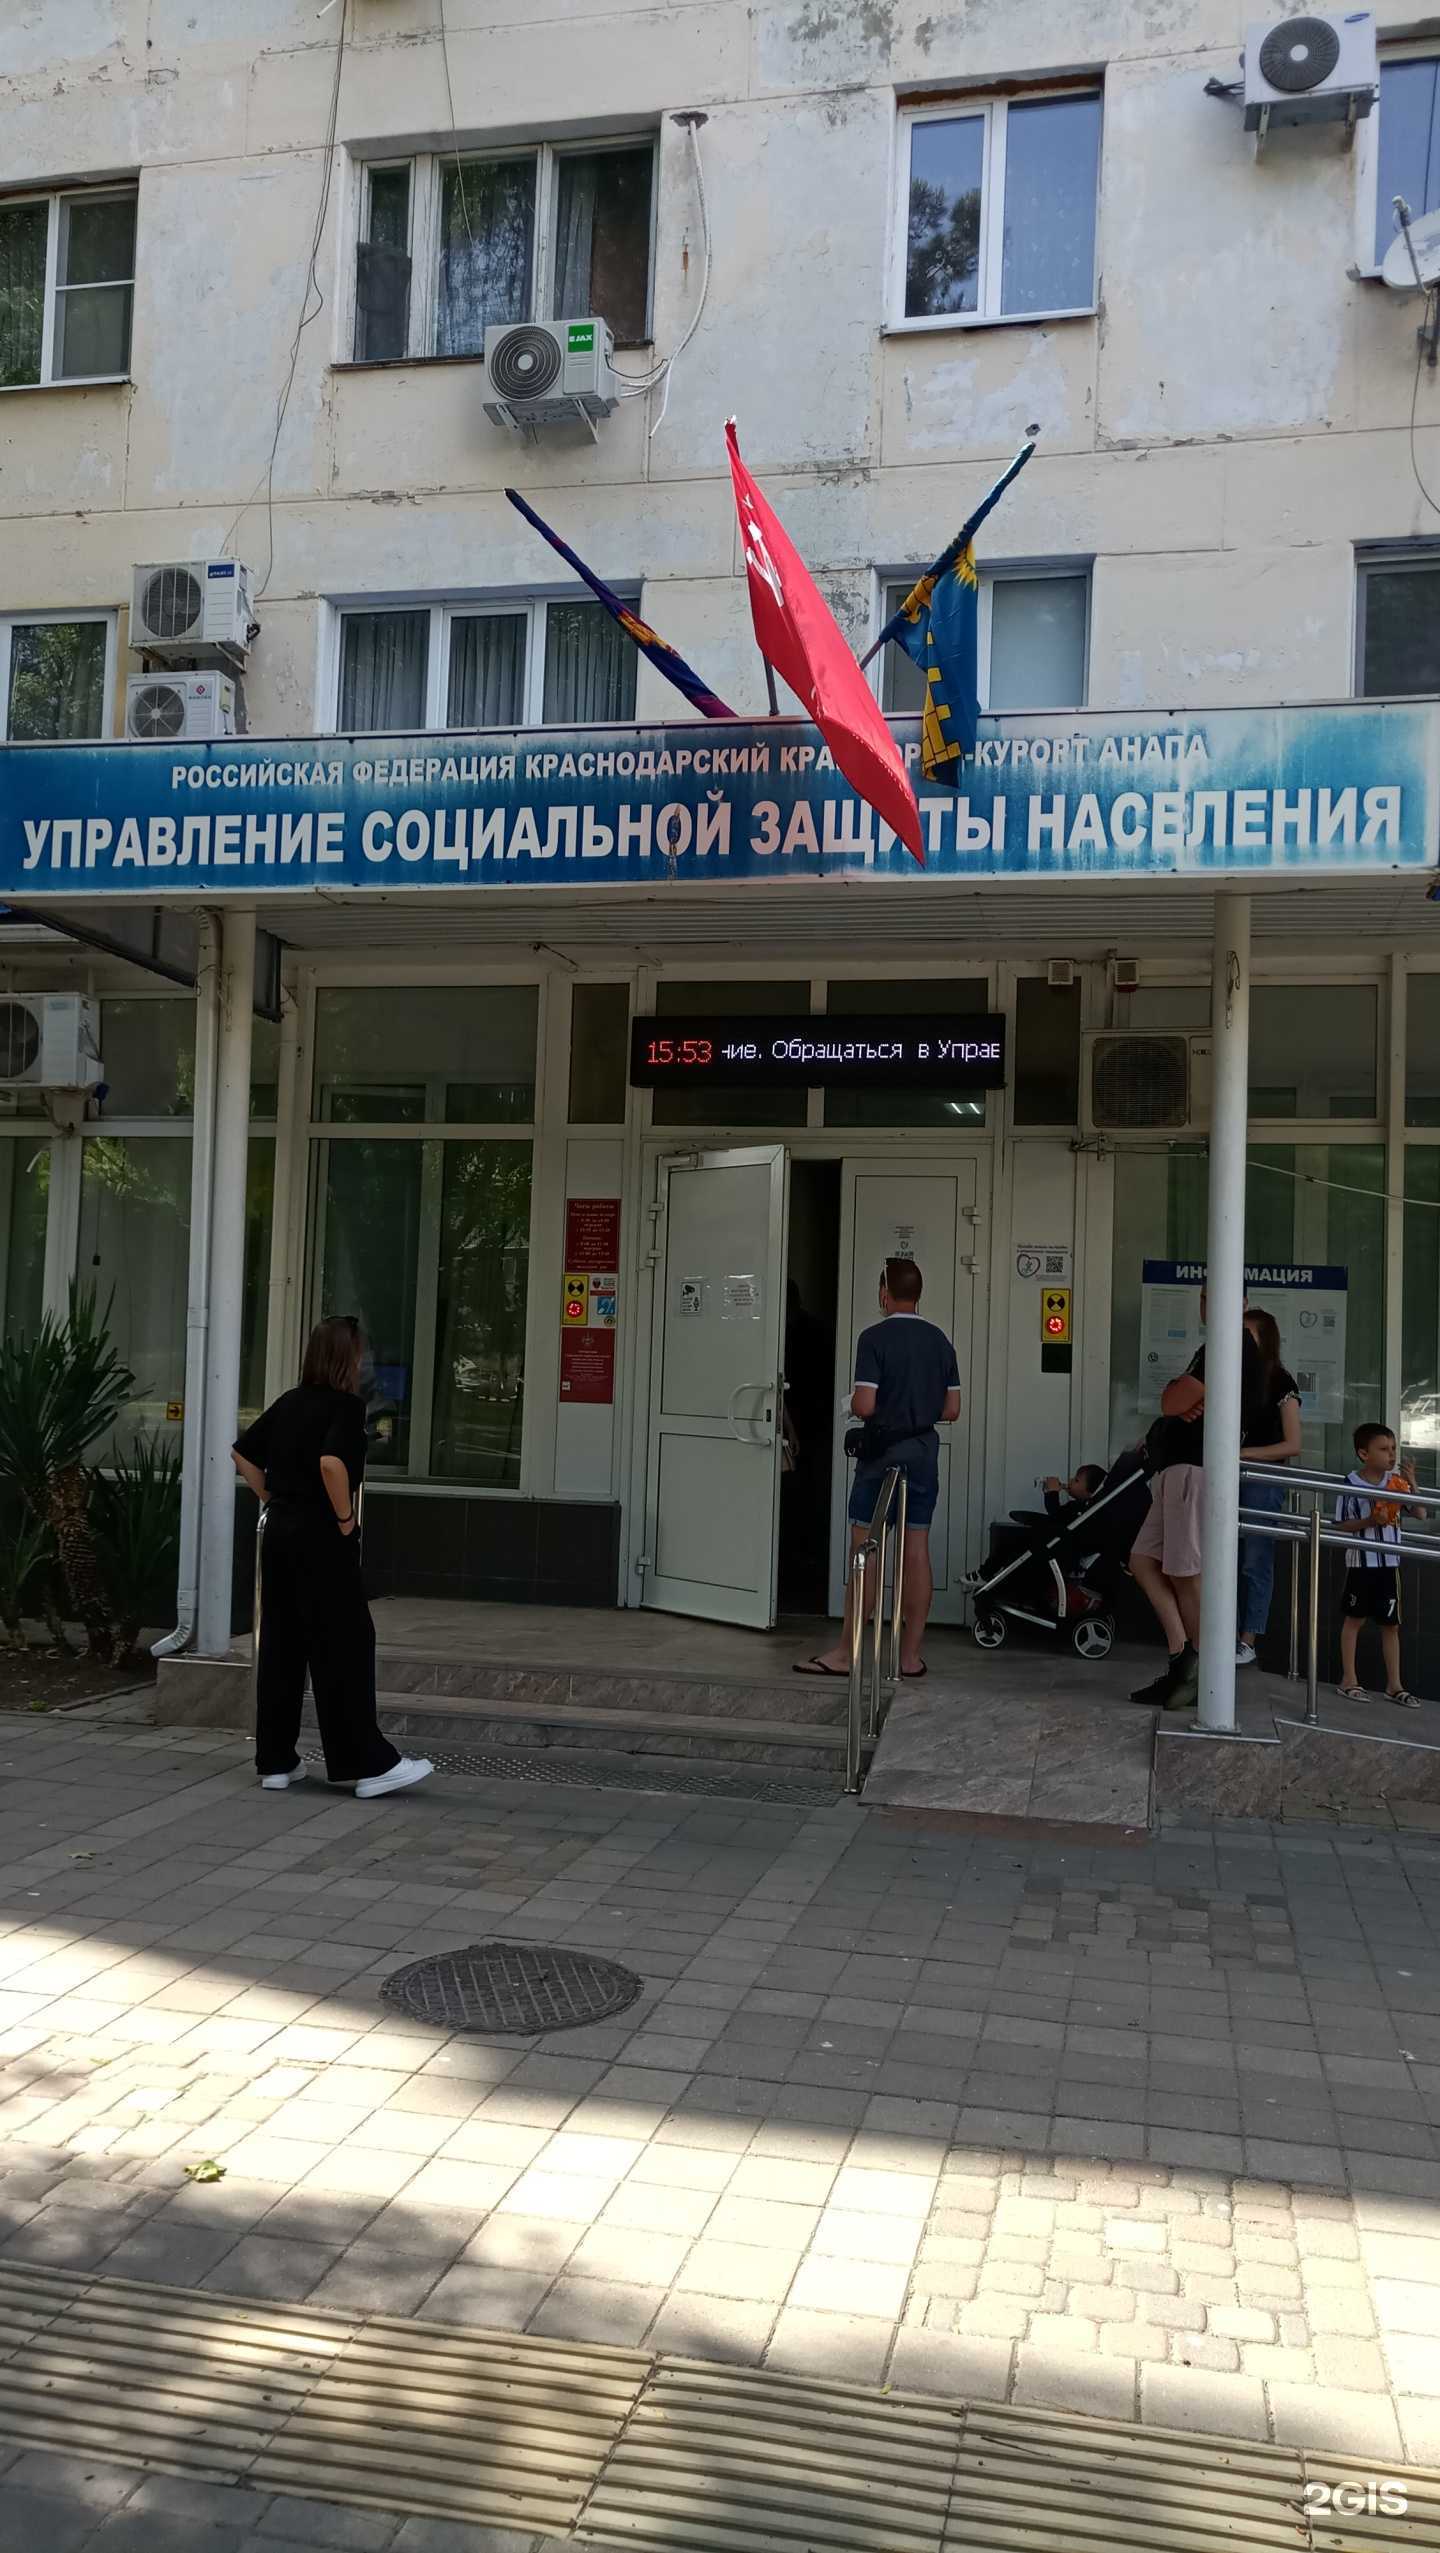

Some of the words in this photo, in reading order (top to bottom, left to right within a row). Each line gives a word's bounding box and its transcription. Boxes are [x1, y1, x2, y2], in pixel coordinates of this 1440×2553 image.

[171, 757, 344, 790] РОССИЙСКАЯ
[352, 754, 516, 787] ФЕДЕРАЦИЯ
[524, 741, 770, 780] КРАСНОДАРСКИЙ
[779, 745, 842, 774] КРА
[1099, 733, 1209, 766] АНАПА
[22, 811, 345, 870] УПРАВЛЕНИЕ
[362, 788, 731, 870] СОЦИАЛЬНОЙ
[1027, 786, 1401, 852] НАСЕЛЕНИЯ
[648, 1040, 712, 1063] 15:53
[772, 1038, 903, 1063] Обращаться
[918, 1043, 930, 1059] в
[1176, 1265, 1313, 1284] ИНМАЦИЯ
